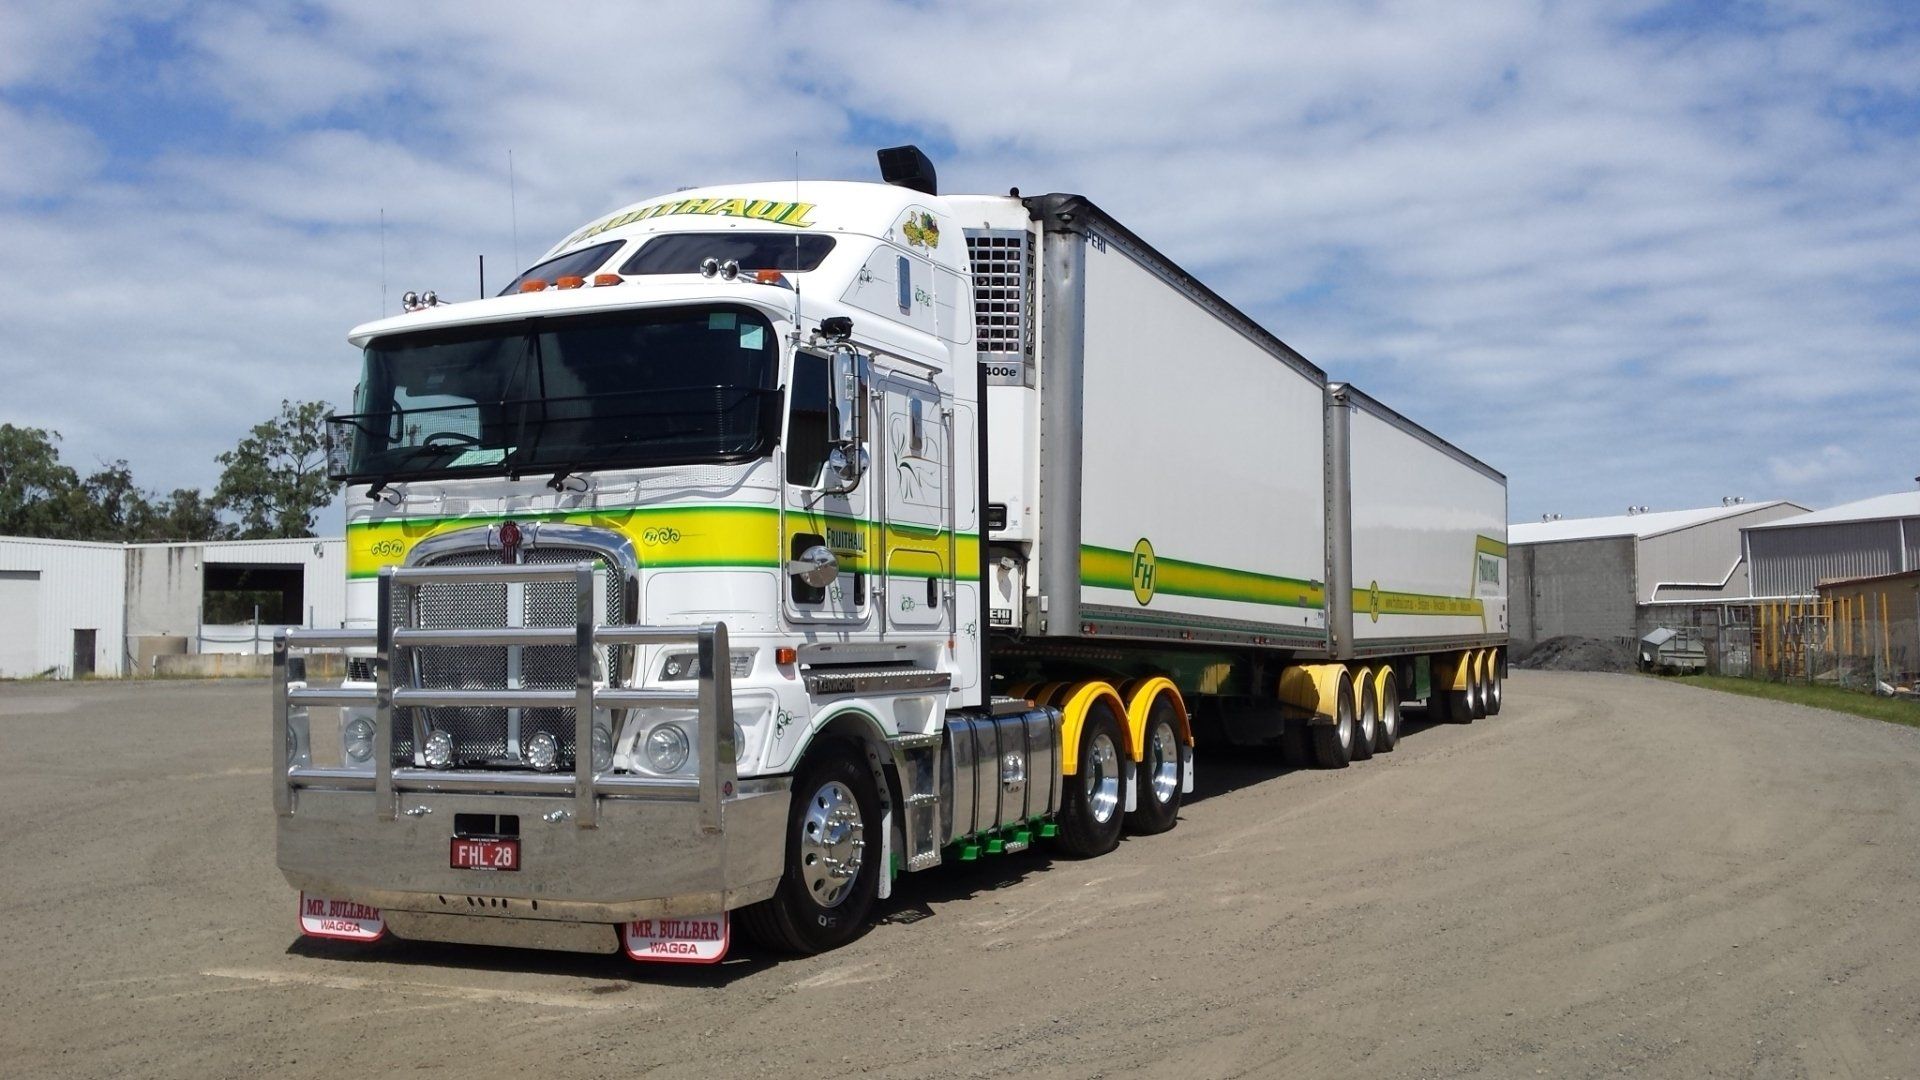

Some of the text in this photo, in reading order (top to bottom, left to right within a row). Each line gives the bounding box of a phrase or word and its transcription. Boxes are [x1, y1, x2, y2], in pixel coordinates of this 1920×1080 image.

[826, 528, 867, 553] FRUITHAUL
[1134, 553, 1154, 590] FH
[817, 678, 856, 693] KENWORTH
[306, 899, 380, 921] MR. BULLBAR
[320, 920, 361, 933] WAGGA
[631, 919, 720, 940] MR. BULLBAR
[650, 942, 698, 955] WAGGA
